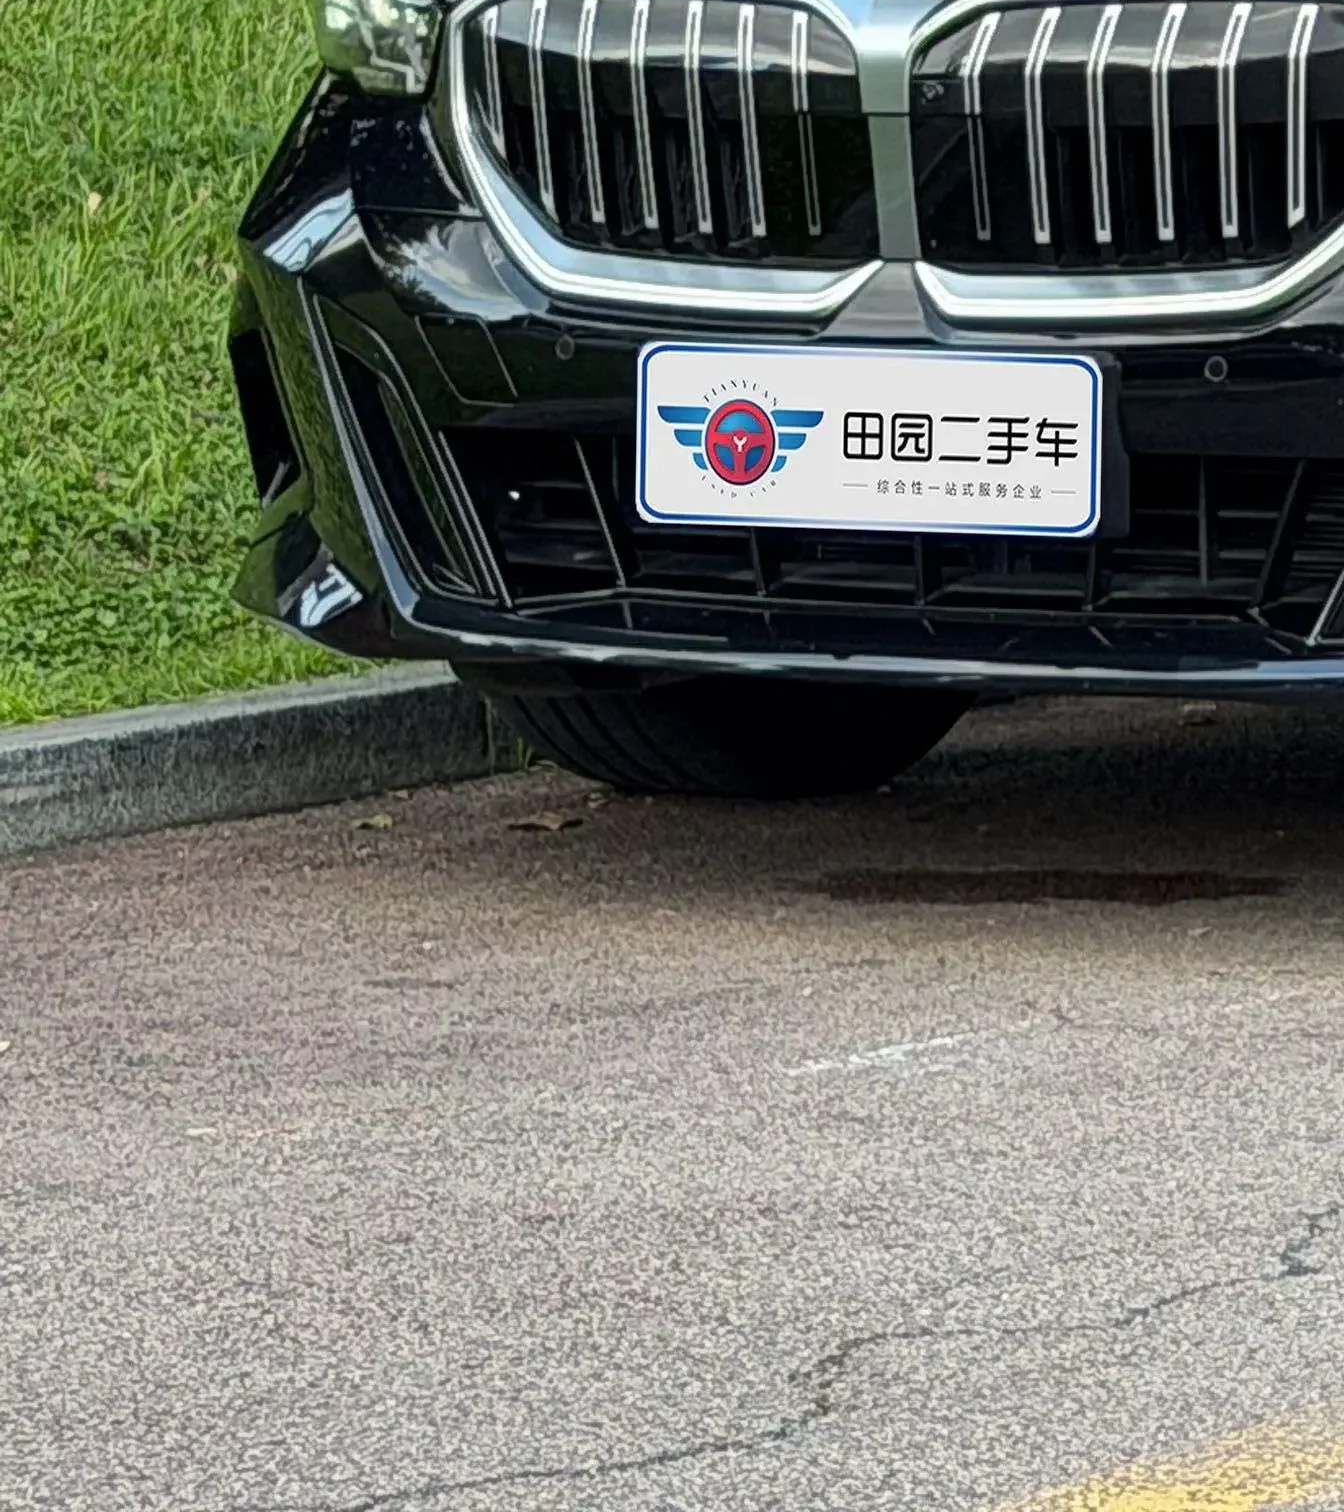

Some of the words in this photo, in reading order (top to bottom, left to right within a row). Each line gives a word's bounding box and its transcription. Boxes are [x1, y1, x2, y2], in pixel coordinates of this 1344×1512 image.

[843, 411, 1079, 467] 田园二手车
[877, 478, 1043, 500] 综合性一站式服务企业
